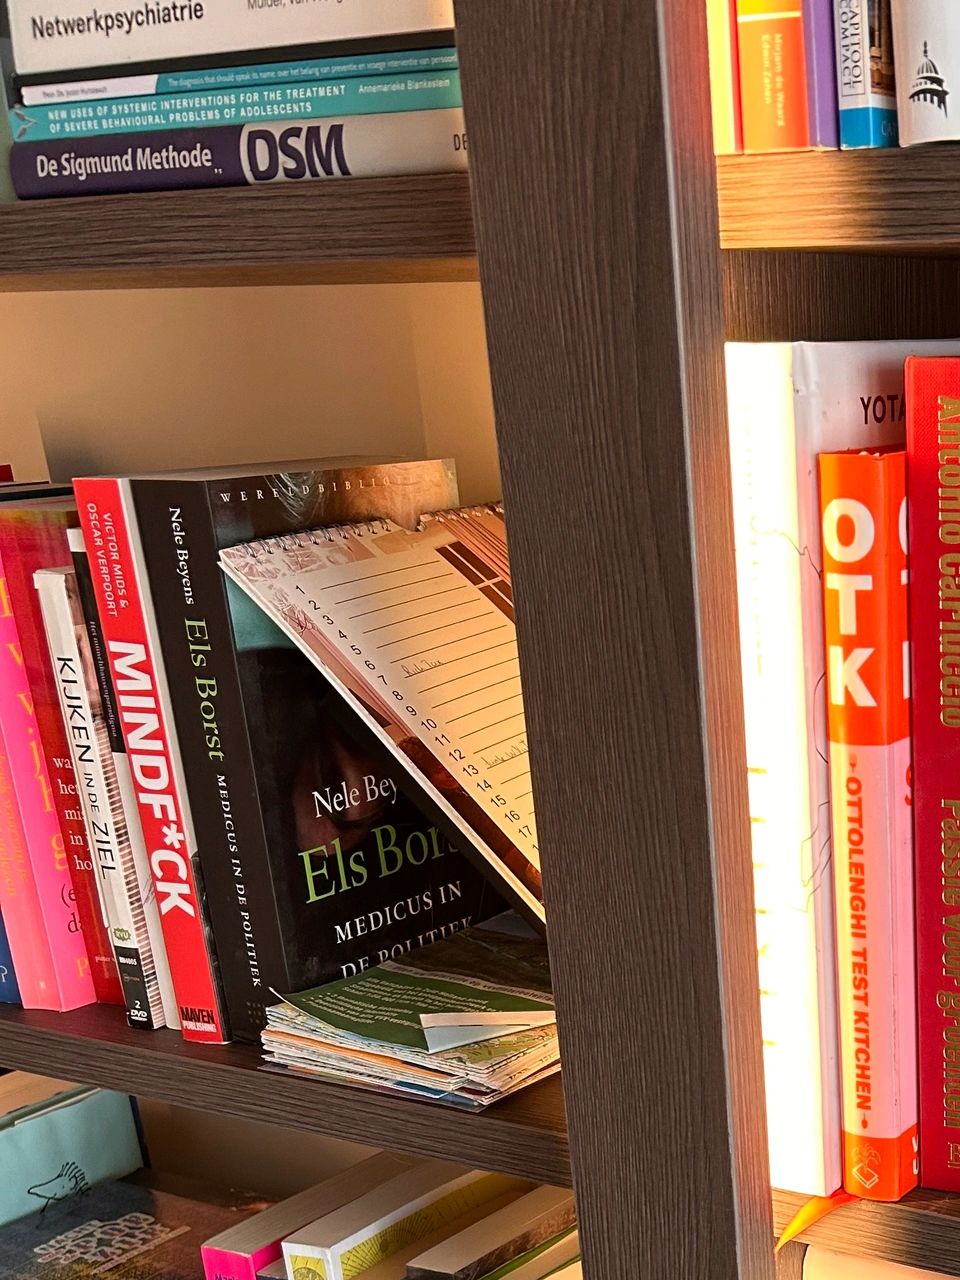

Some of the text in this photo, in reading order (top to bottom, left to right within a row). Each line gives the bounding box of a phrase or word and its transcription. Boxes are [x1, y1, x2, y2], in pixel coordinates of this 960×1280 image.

[31, 0, 204, 39] Netwerkpsychiatrie
[48, 85, 346, 120] NEW USES SYSTEMIC INTERVENTIONS FOR THE TREATMENT
[65, 102, 312, 131] SEVERE BEHAVIOURAL PROBLEMS ADOLESCENTS
[37, 144, 212, 179] De Sigmund Methode
[247, 123, 351, 181] DSM
[87, 503, 117, 617] OSCAR VERPOORT
[103, 512, 127, 597] VICTOR MIDS
[169, 507, 194, 605] Nele Beyens
[185, 617, 223, 761] Els Borst
[57, 656, 116, 880] KIJKEN ZIEL
[312, 781, 360, 818] Nele
[217, 774, 261, 986] MEDICUS POLITIEK
[298, 838, 368, 904] Els
[335, 881, 462, 944] MEDICUS IN
[845, 776, 871, 1110] OTTOLENGHI TEST KITCHEN
[180, 1006, 215, 1024] MAVEN
